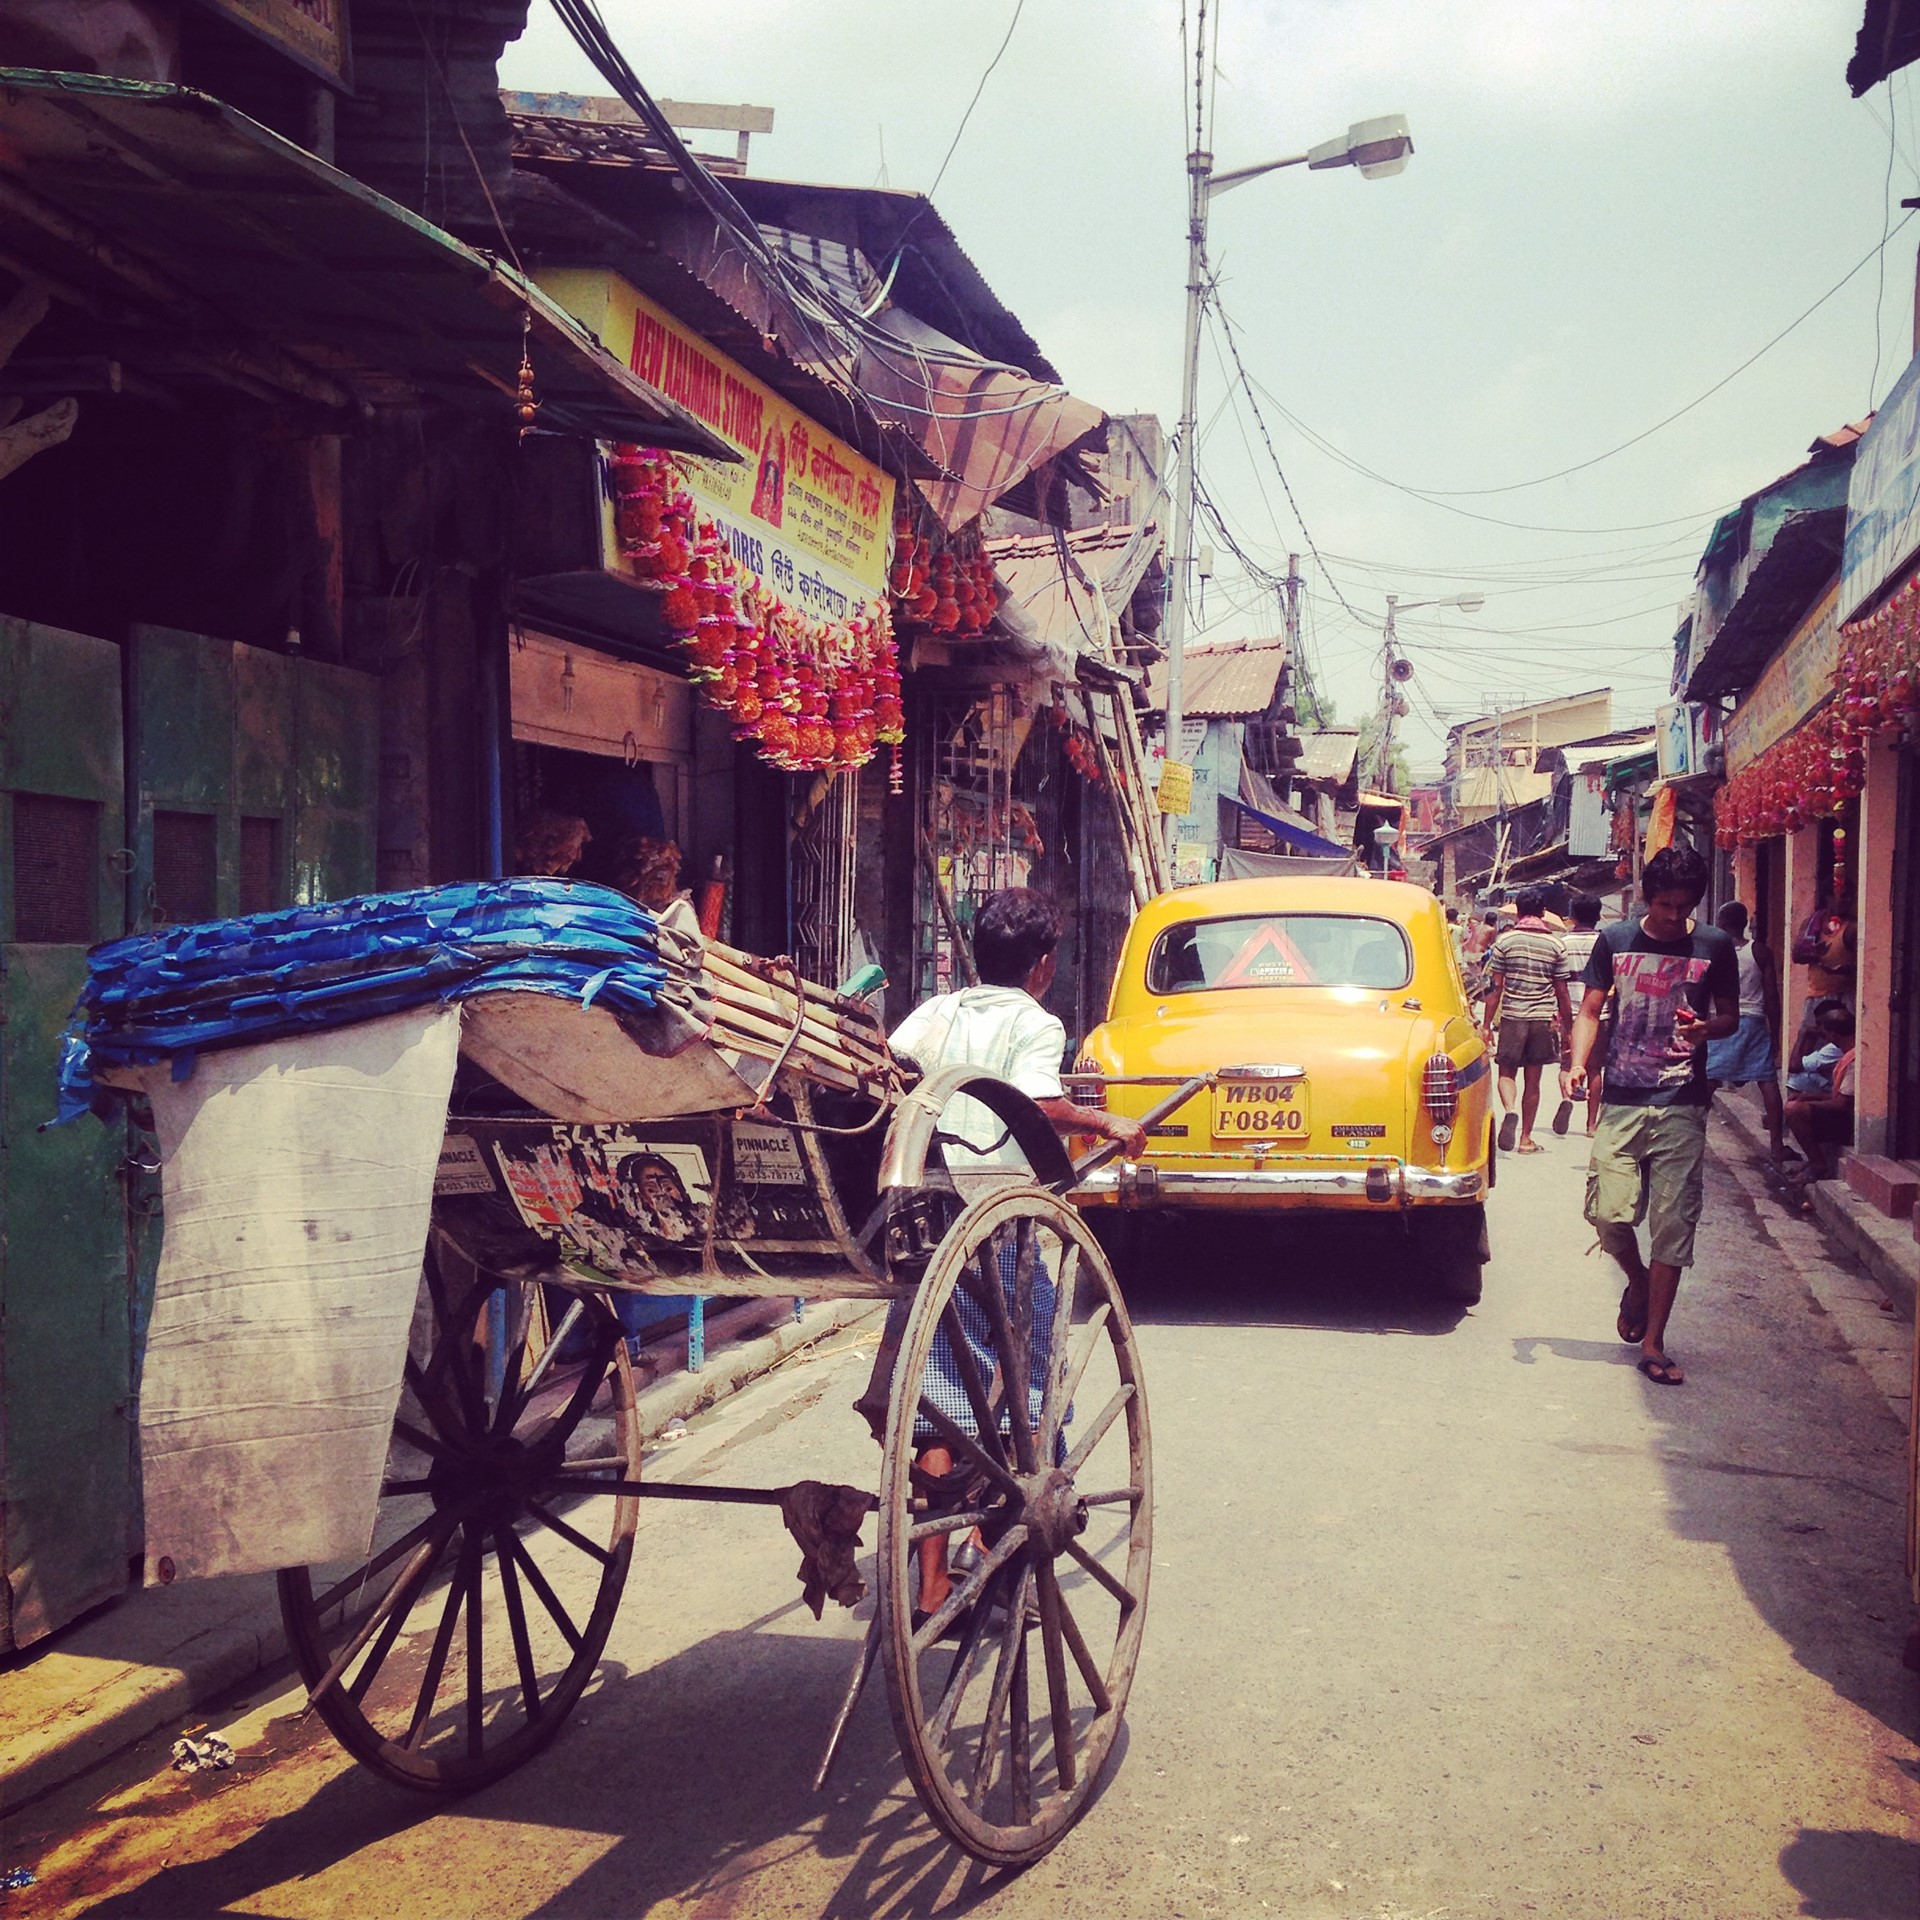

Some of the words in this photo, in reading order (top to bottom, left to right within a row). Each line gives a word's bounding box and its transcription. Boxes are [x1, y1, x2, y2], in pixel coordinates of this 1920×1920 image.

[630, 308, 666, 391] NEW
[722, 372, 763, 455] STORES
[736, 1137, 790, 1153] PINNACLE
